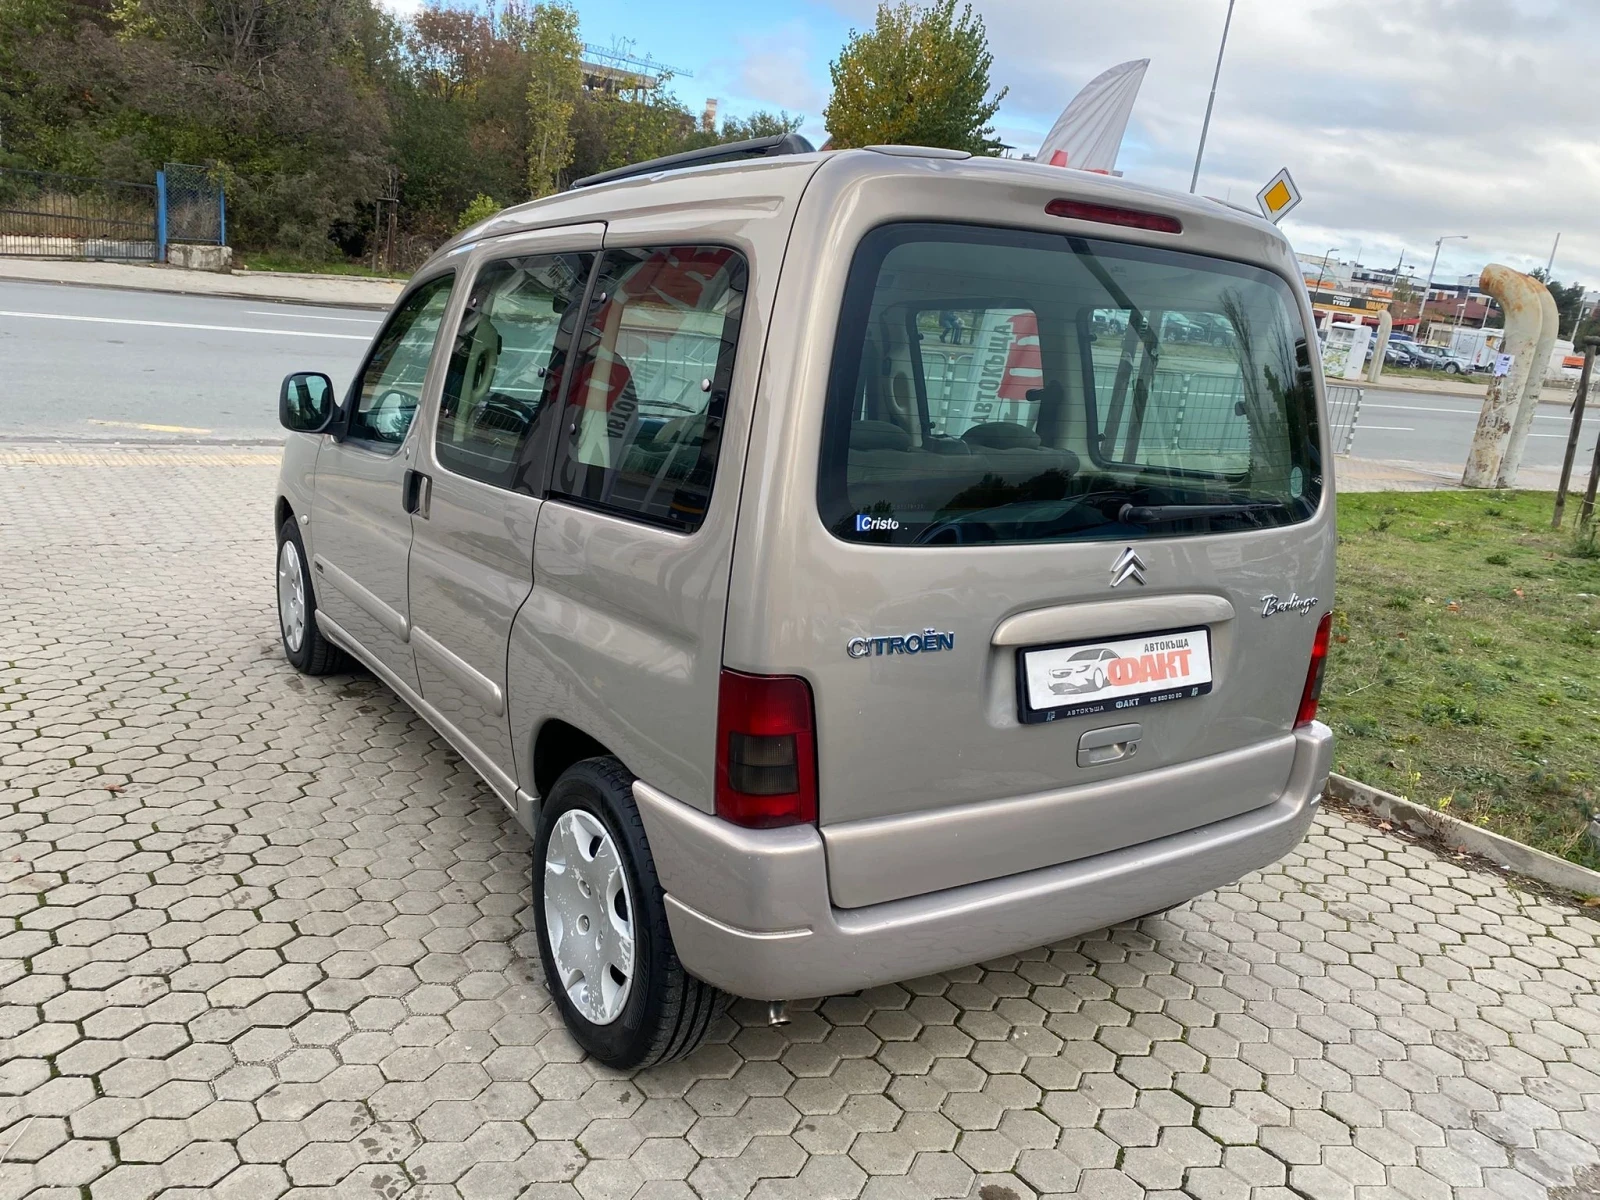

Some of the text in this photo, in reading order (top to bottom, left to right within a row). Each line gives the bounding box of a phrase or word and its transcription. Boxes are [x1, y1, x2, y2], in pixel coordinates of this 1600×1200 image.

[1260, 592, 1318, 618] Berlingo
[846, 627, 954, 659] CITROËN
[1144, 638, 1189, 653] АВТОКЪЩА
[1108, 649, 1191, 686] ФАКТ
[1115, 698, 1140, 709] ФАКТ
